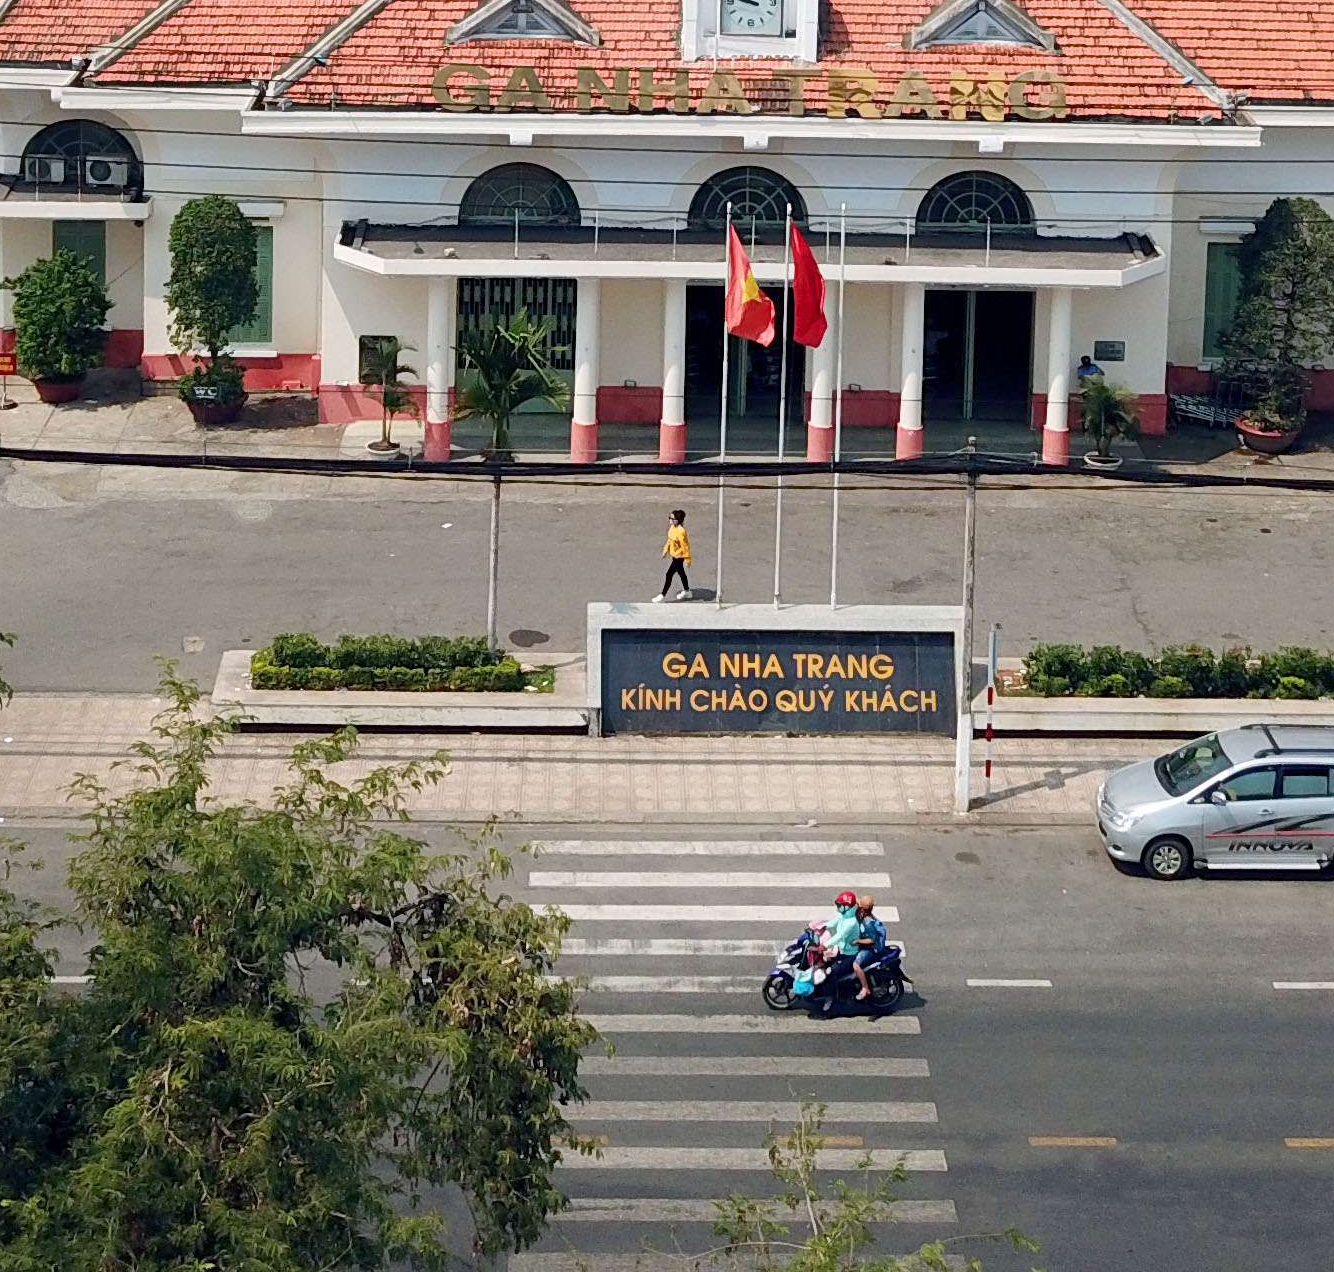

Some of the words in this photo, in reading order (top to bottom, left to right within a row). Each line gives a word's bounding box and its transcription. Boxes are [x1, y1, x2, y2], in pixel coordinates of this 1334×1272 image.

[432, 63, 555, 112] GA
[577, 66, 752, 115] NHA
[771, 68, 1067, 121] TRANG
[193, 386, 218, 396] WC
[662, 651, 711, 680] GA
[719, 652, 785, 680] NHA
[793, 653, 895, 681] TRANG
[621, 682, 681, 712] KÍNH
[689, 683, 768, 713] CHÀO
[775, 683, 834, 714] QUÝ
[845, 683, 938, 713] KHÁCH
[1228, 839, 1314, 852] INNOVA
